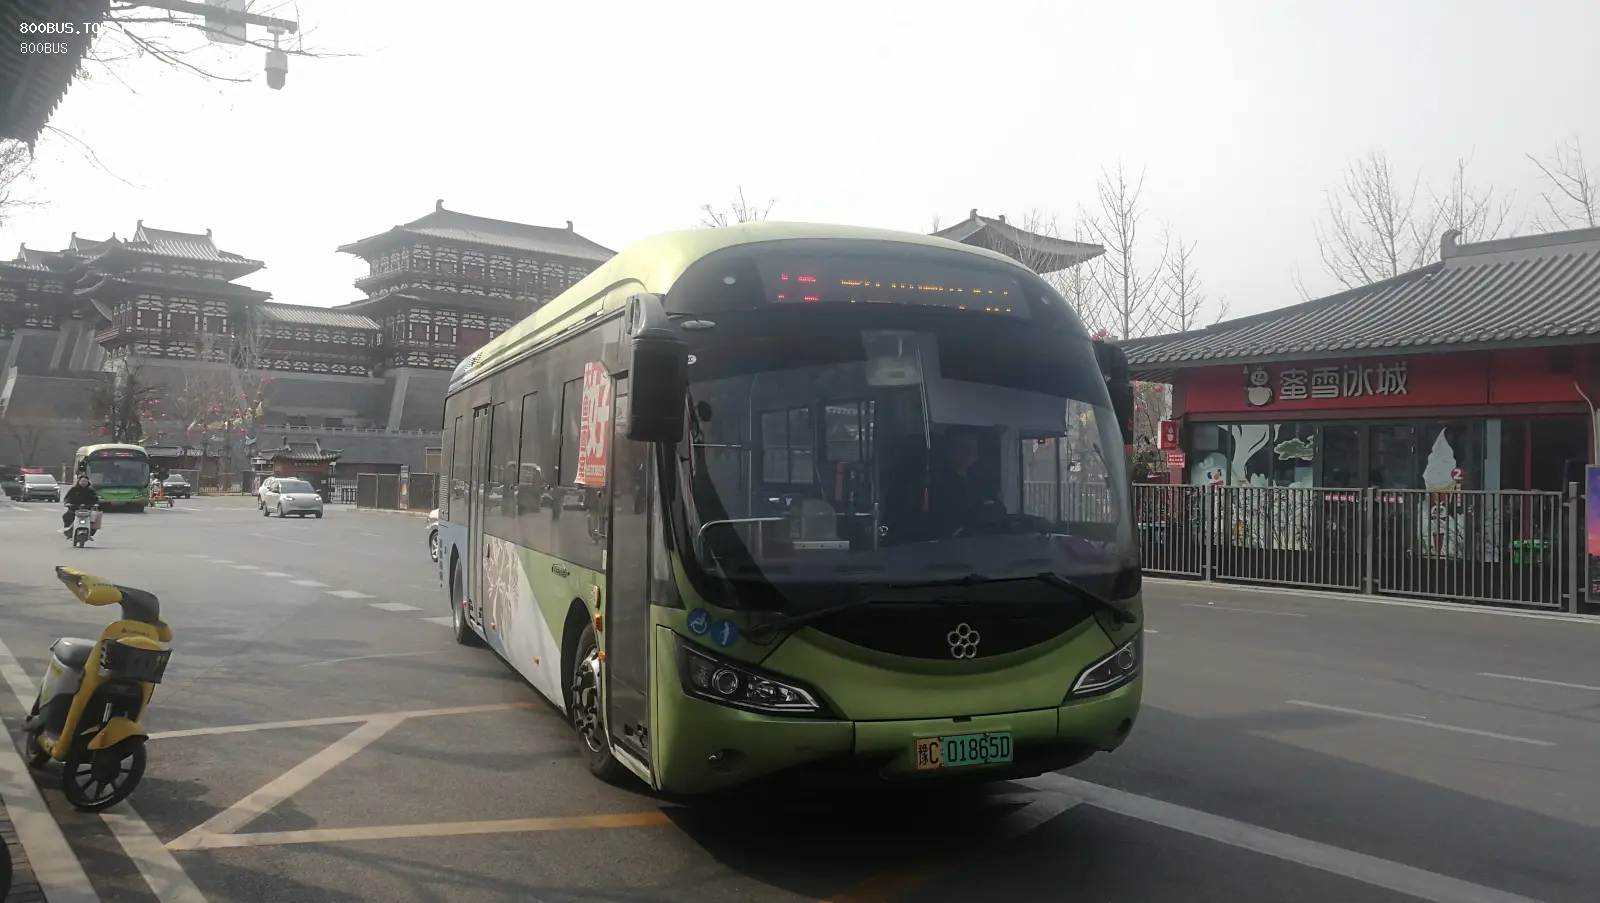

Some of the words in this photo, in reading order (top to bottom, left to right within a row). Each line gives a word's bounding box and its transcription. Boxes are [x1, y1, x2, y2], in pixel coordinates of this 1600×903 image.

[1279, 362, 1408, 400] 蜜雪冰城
[1453, 468, 1463, 480] 2
